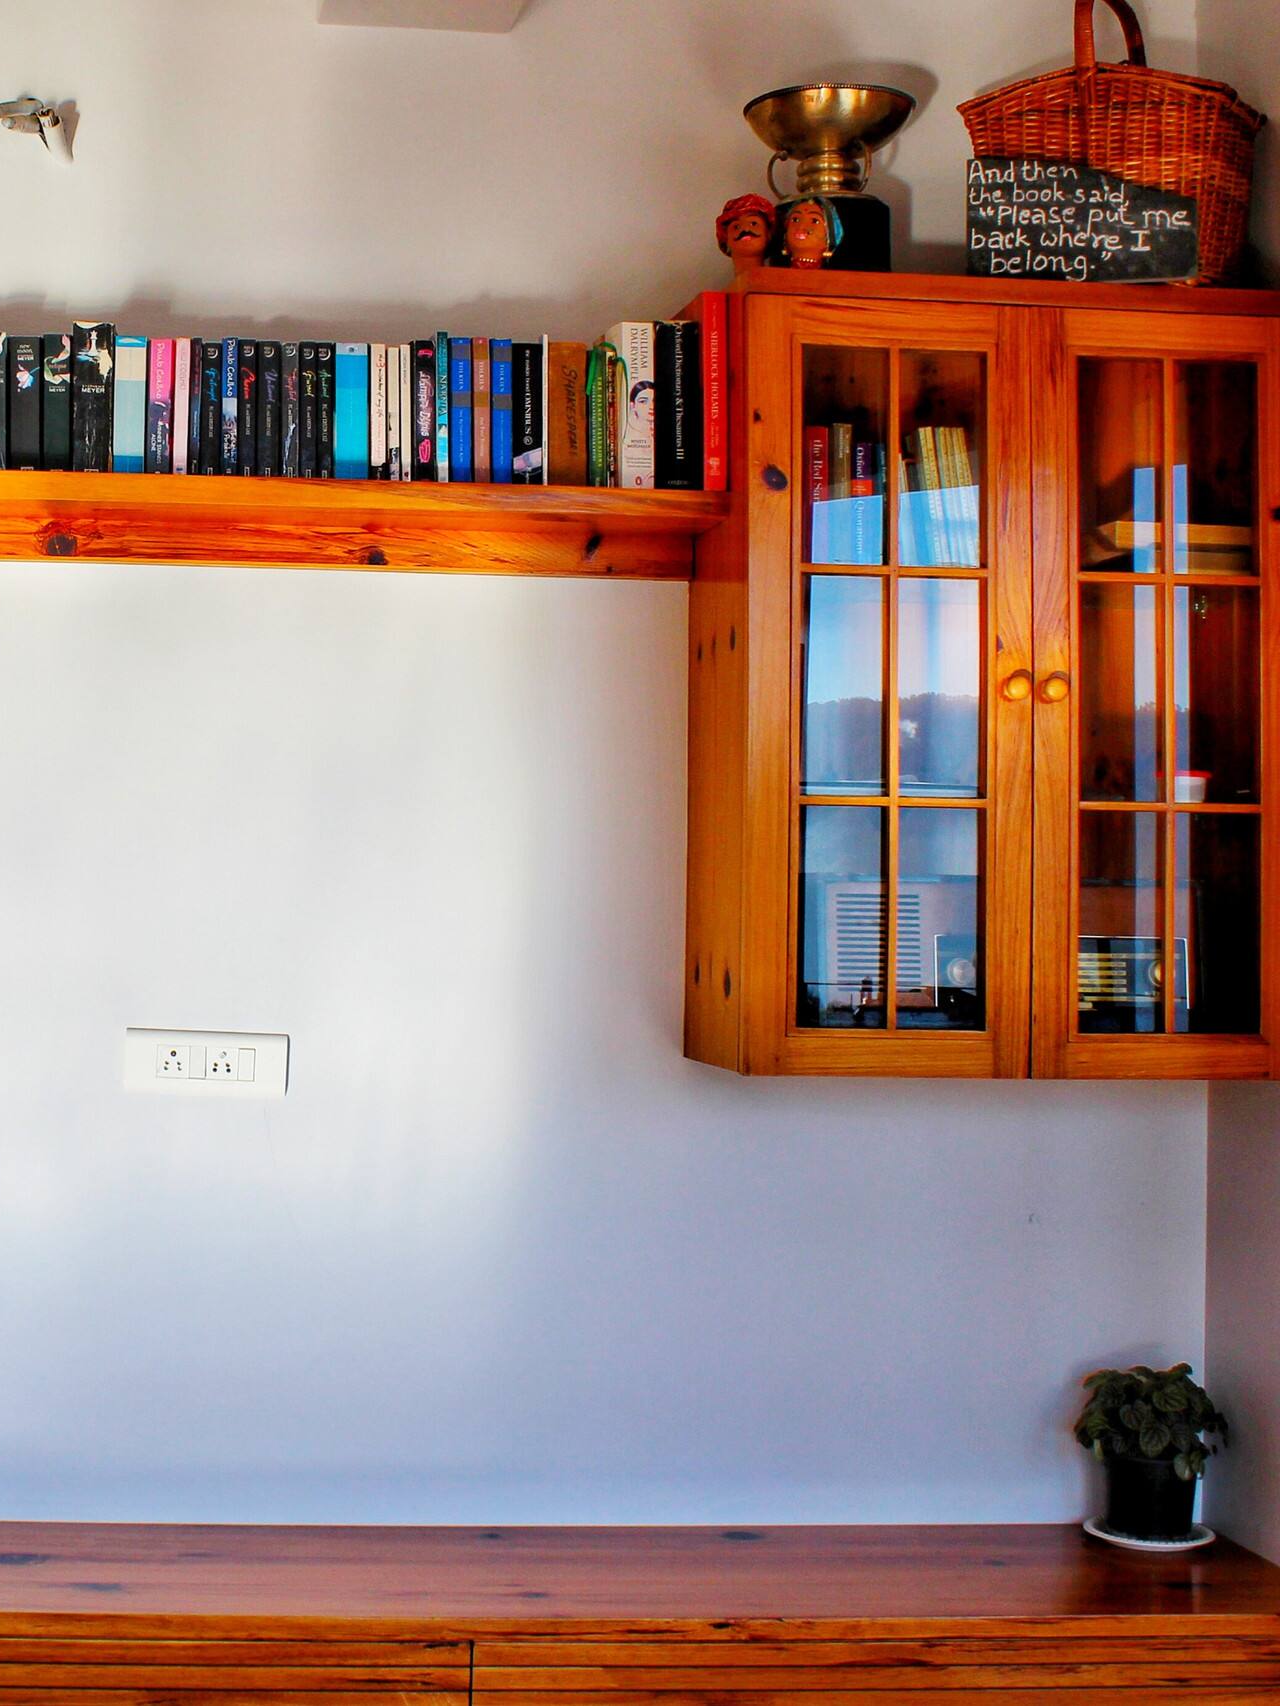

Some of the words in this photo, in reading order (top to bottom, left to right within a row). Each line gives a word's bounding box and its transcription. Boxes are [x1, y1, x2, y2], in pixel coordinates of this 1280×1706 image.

[968, 160, 1015, 185] And
[1021, 160, 1078, 180] then
[968, 186, 1006, 205] the
[1013, 183, 1065, 203] book
[1073, 184, 1130, 206] said,
[1088, 205, 1135, 235] put
[1143, 210, 1191, 229] me
[971, 228, 1031, 250] back
[1040, 225, 1123, 251] where
[1130, 230, 1151, 252] I
[227, 339, 235, 364] Paulo
[640, 328, 648, 369] WILLIAM
[673, 322, 684, 352] Oxford
[155, 343, 165, 368] Paulo
[630, 328, 639, 381] DALRYMPLE
[710, 330, 719, 380] SHERLOCK
[155, 369, 165, 399] Coelho
[227, 366, 235, 397] Coelho
[673, 353, 684, 396] Dictionary
[439, 375, 448, 415] NARNIA
[675, 396, 683, 405] &
[710, 382, 719, 420] HOLMES
[675, 406, 684, 448] Thesaurus
[814, 440, 823, 455] the
[856, 447, 866, 478] Oxford
[814, 460, 823, 480] Red
